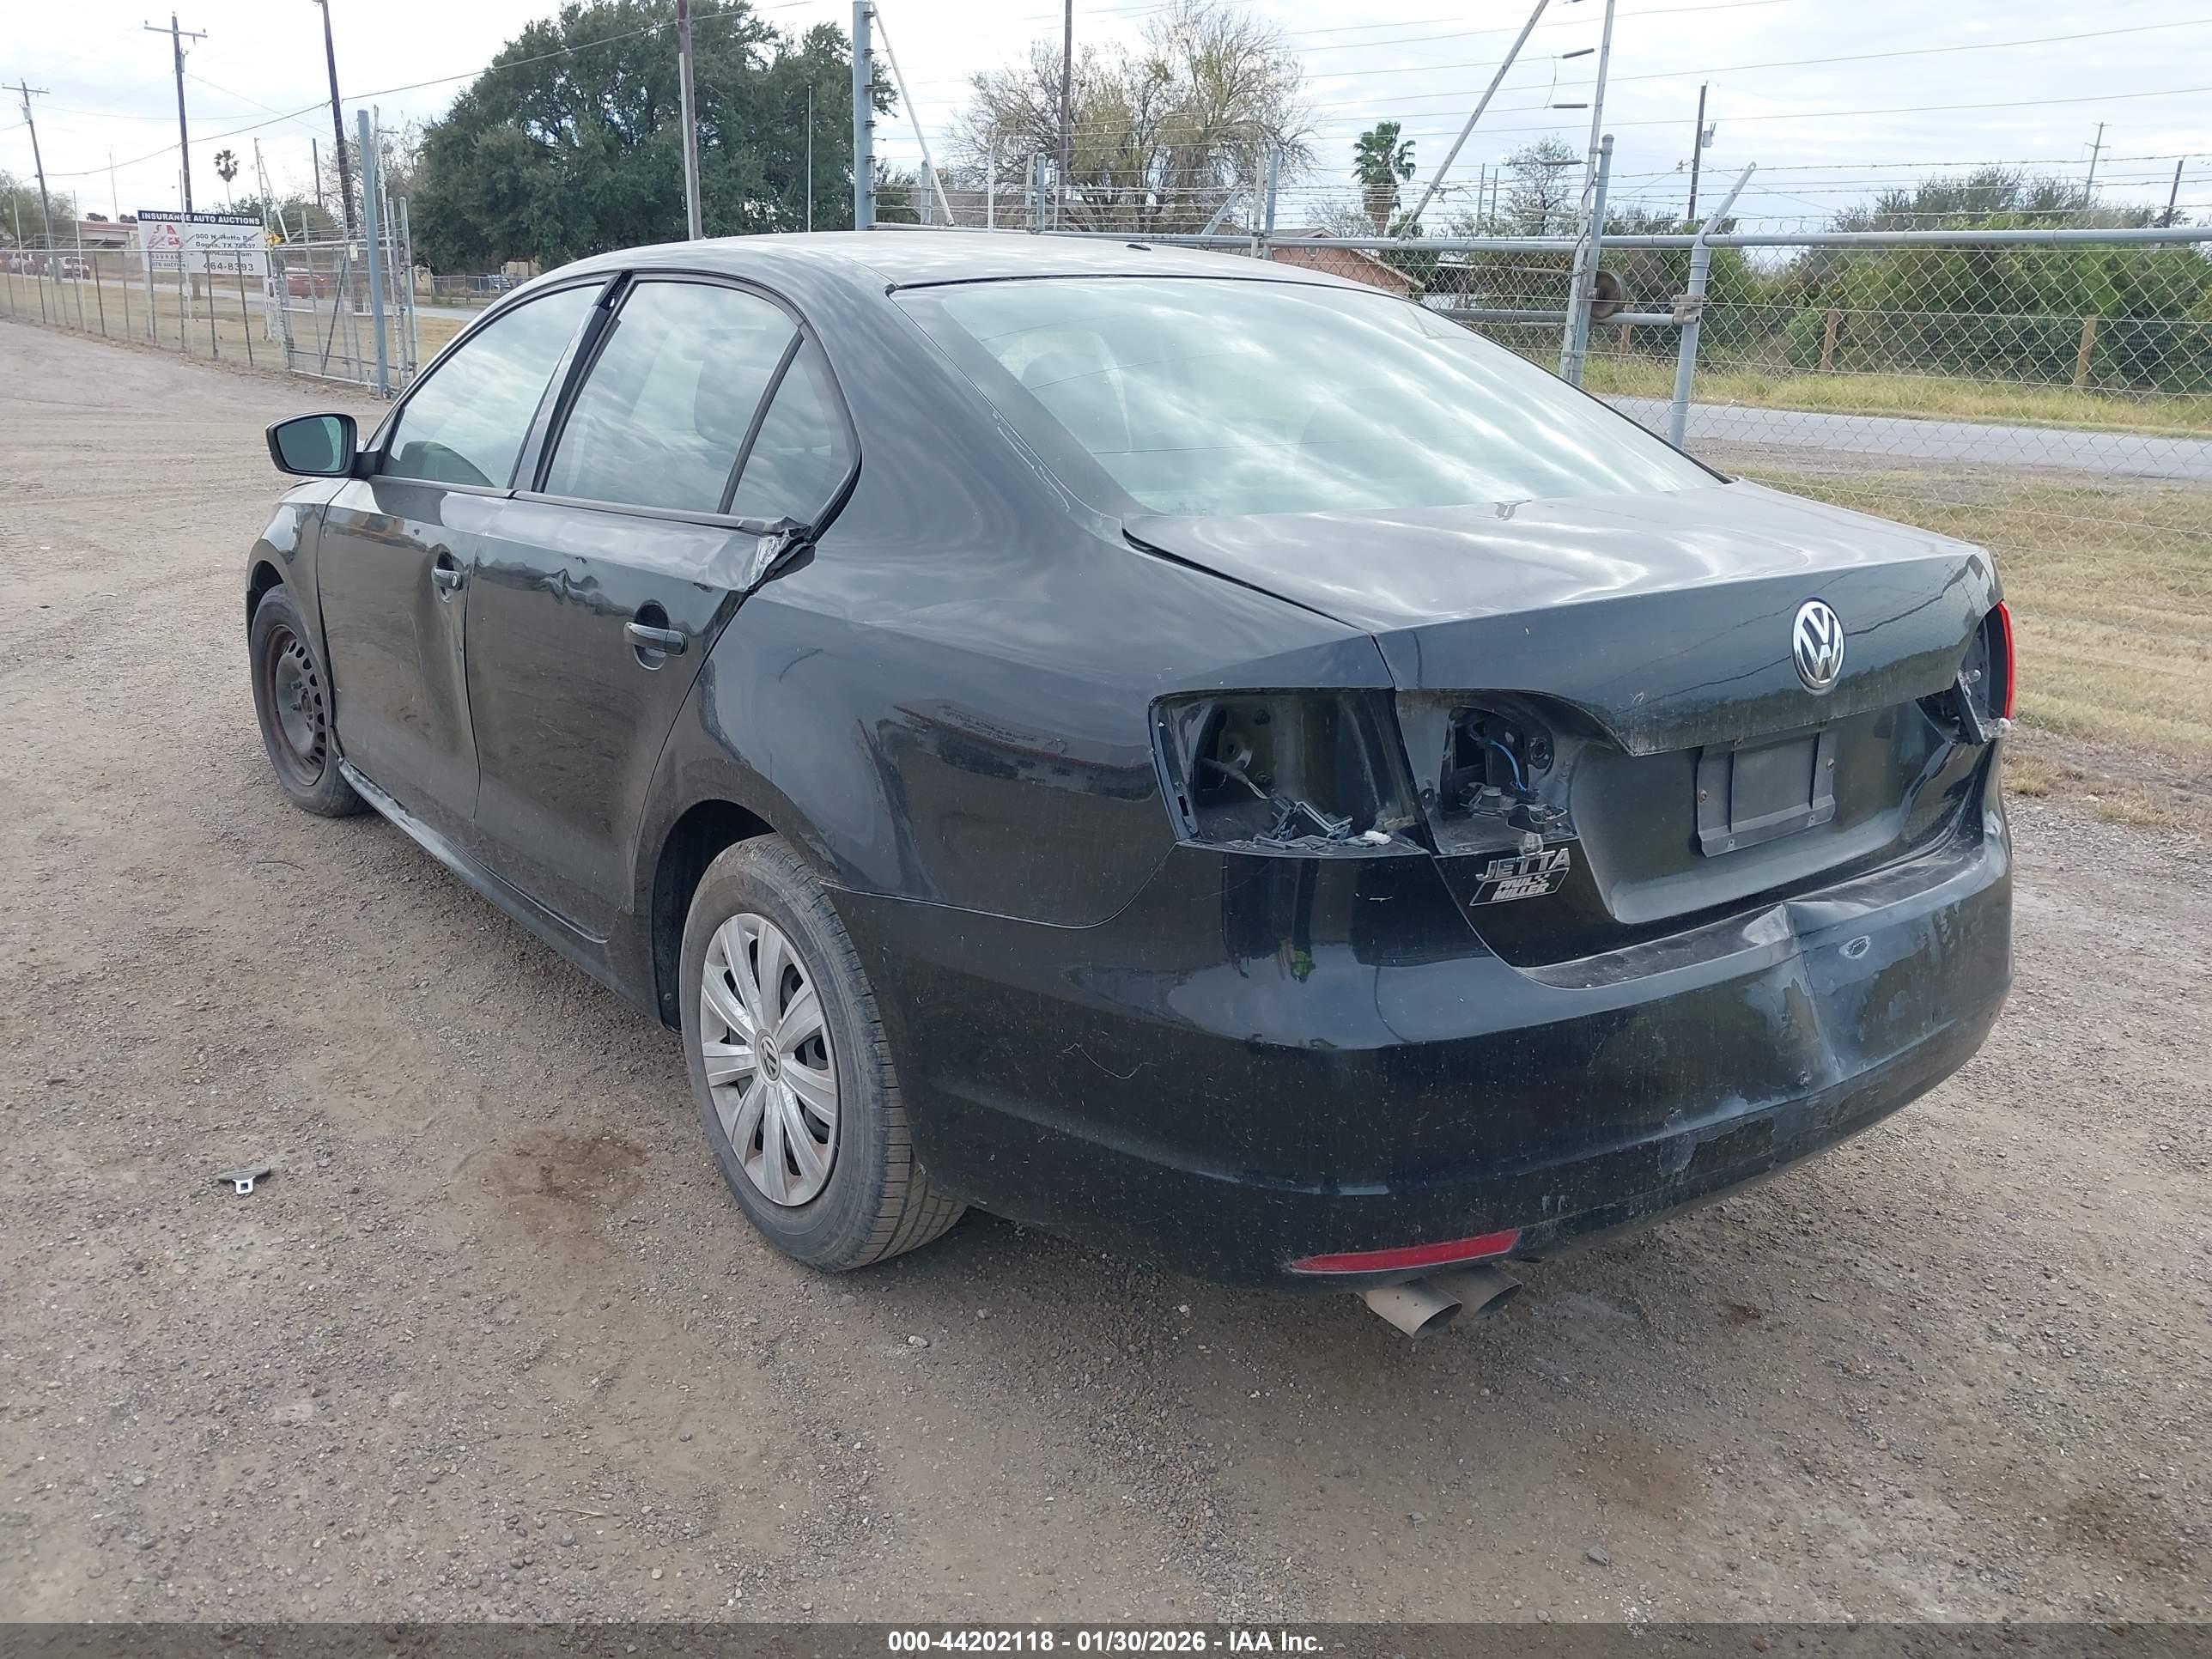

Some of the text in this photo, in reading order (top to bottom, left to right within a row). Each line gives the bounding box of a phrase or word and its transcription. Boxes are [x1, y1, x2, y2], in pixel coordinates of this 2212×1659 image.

[141, 212, 260, 225] INSURANCE AUTO AUCTIONS
[203, 262, 254, 271] 464-8393
[1475, 848, 1571, 881] JETTA
[1497, 876, 1537, 890] PAUL
[1491, 882, 1550, 902] MILLER
